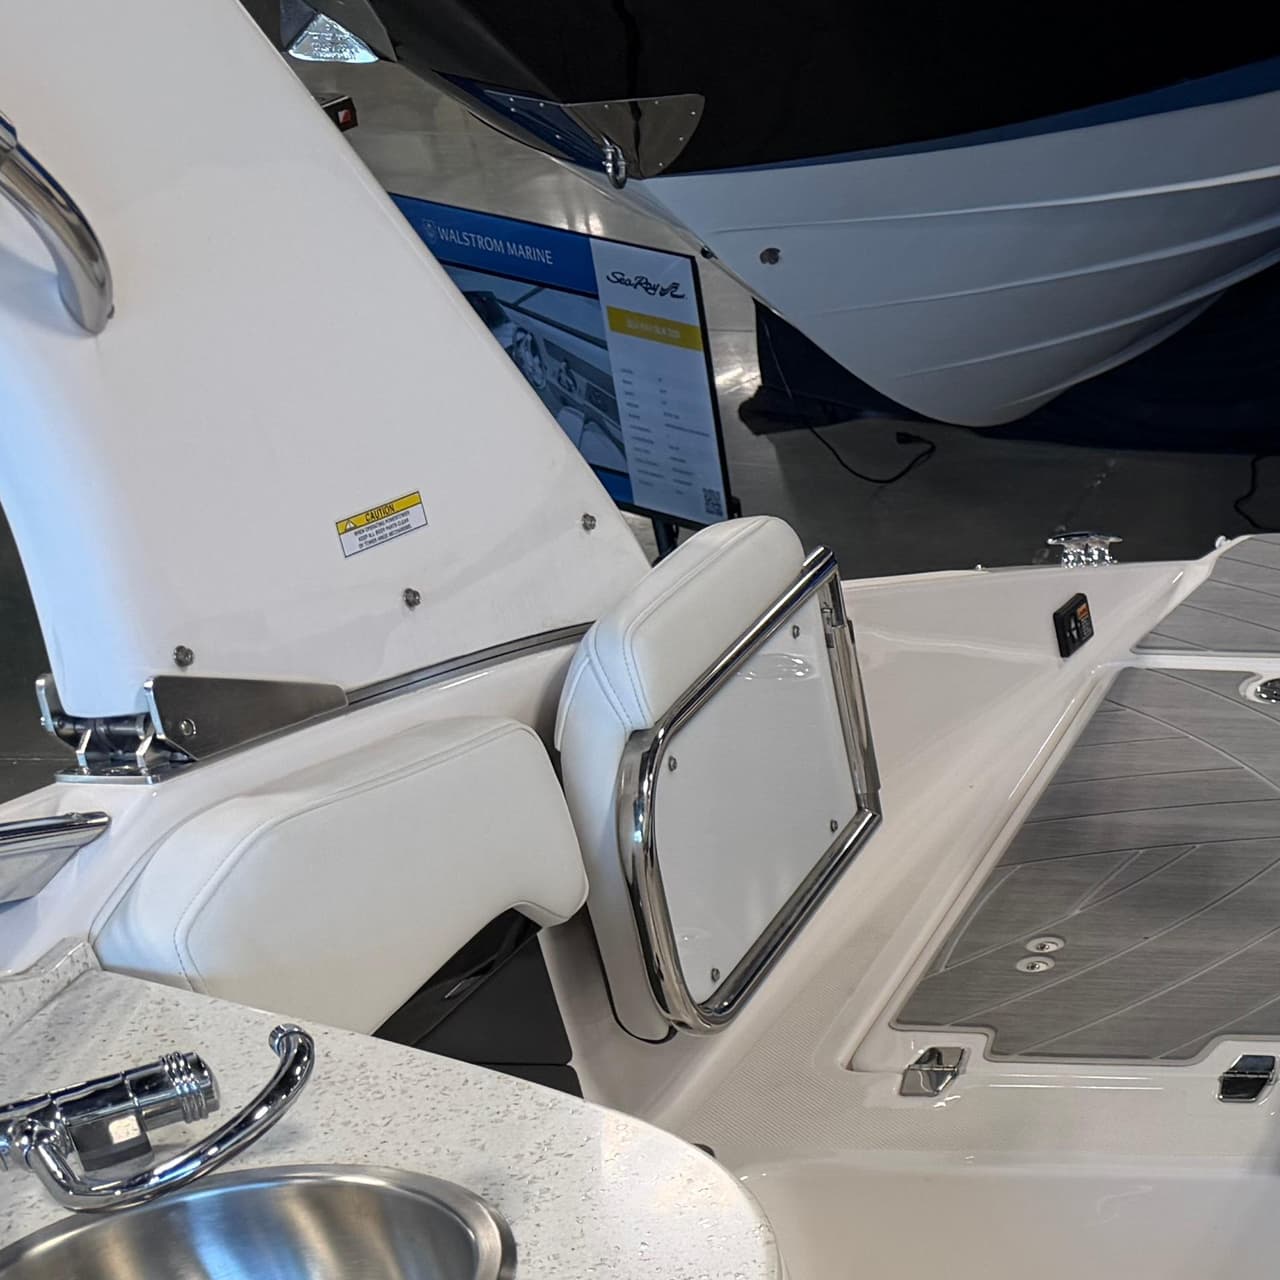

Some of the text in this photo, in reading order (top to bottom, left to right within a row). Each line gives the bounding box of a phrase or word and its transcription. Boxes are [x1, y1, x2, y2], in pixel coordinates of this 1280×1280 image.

[437, 226, 553, 265] WALSTROM MARINE
[365, 503, 395, 522] CAUTION
